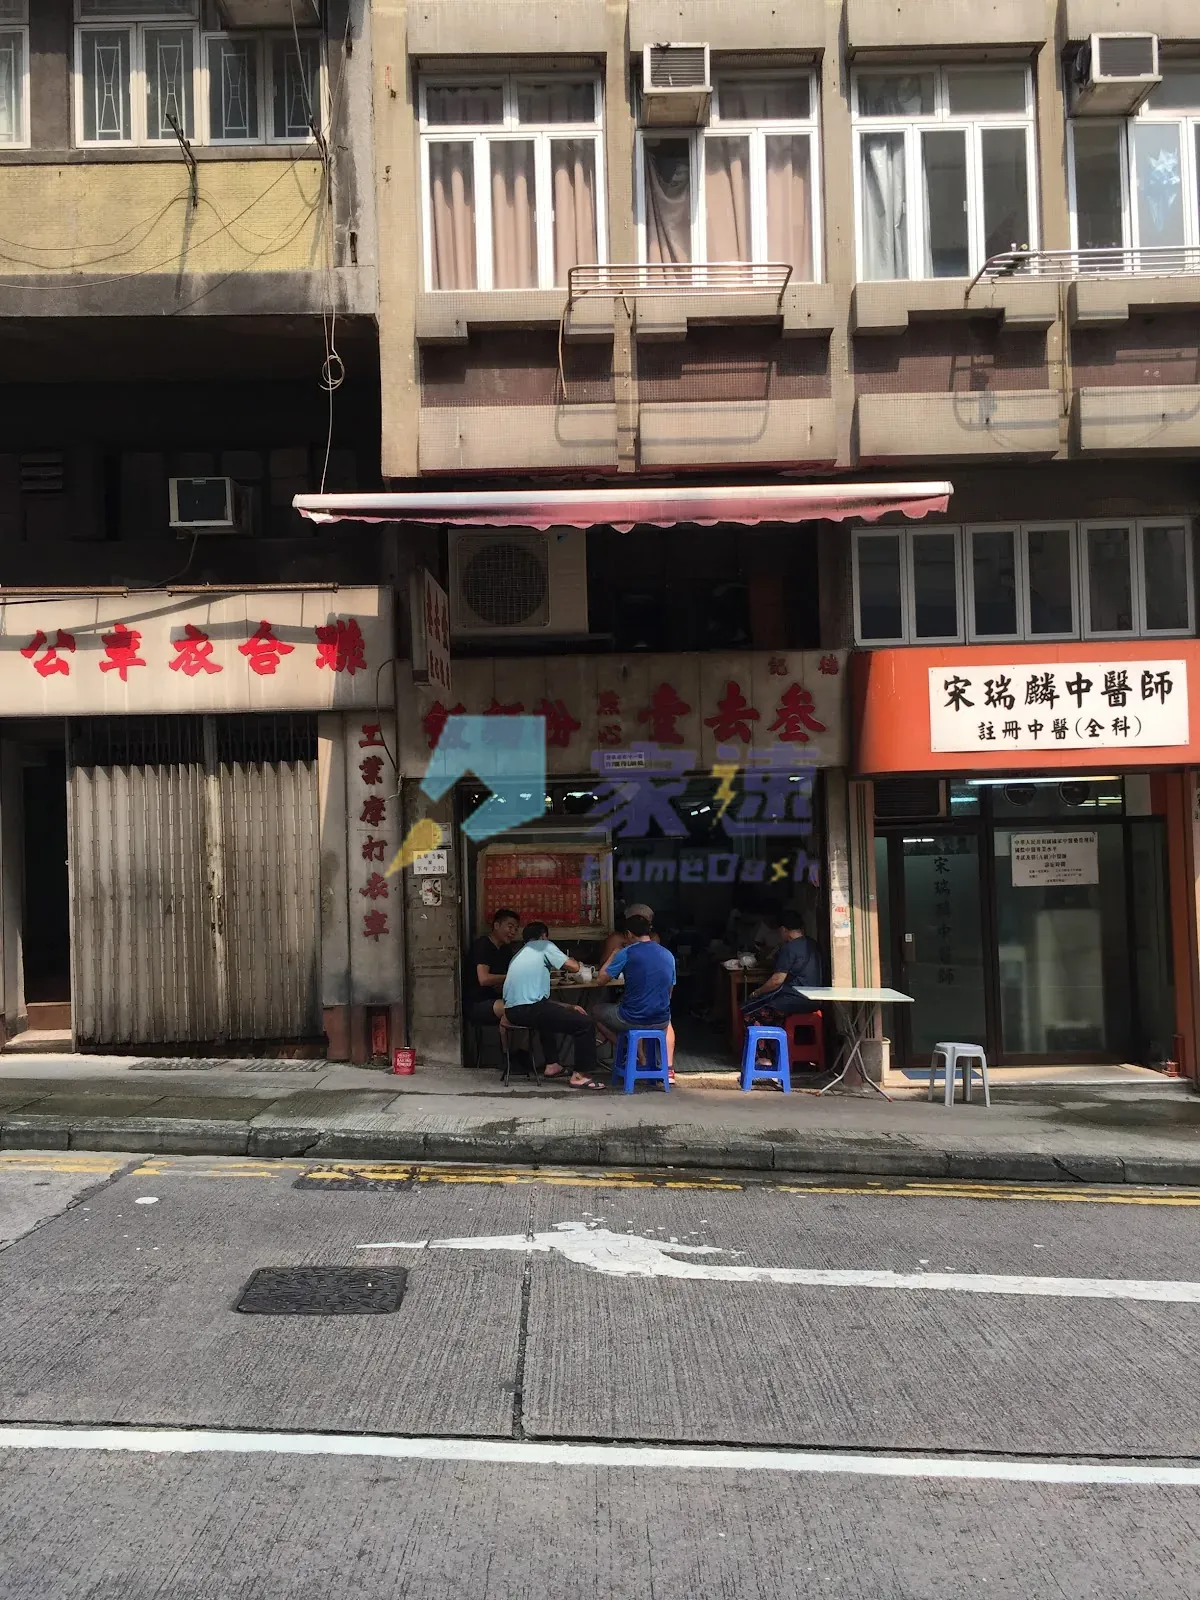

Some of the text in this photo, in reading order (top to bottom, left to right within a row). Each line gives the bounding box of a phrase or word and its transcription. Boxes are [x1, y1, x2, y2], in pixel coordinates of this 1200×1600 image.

[943, 670, 1173, 712] 宋瑞麟中醫師
[359, 723, 390, 942] 工業摩打衣車
